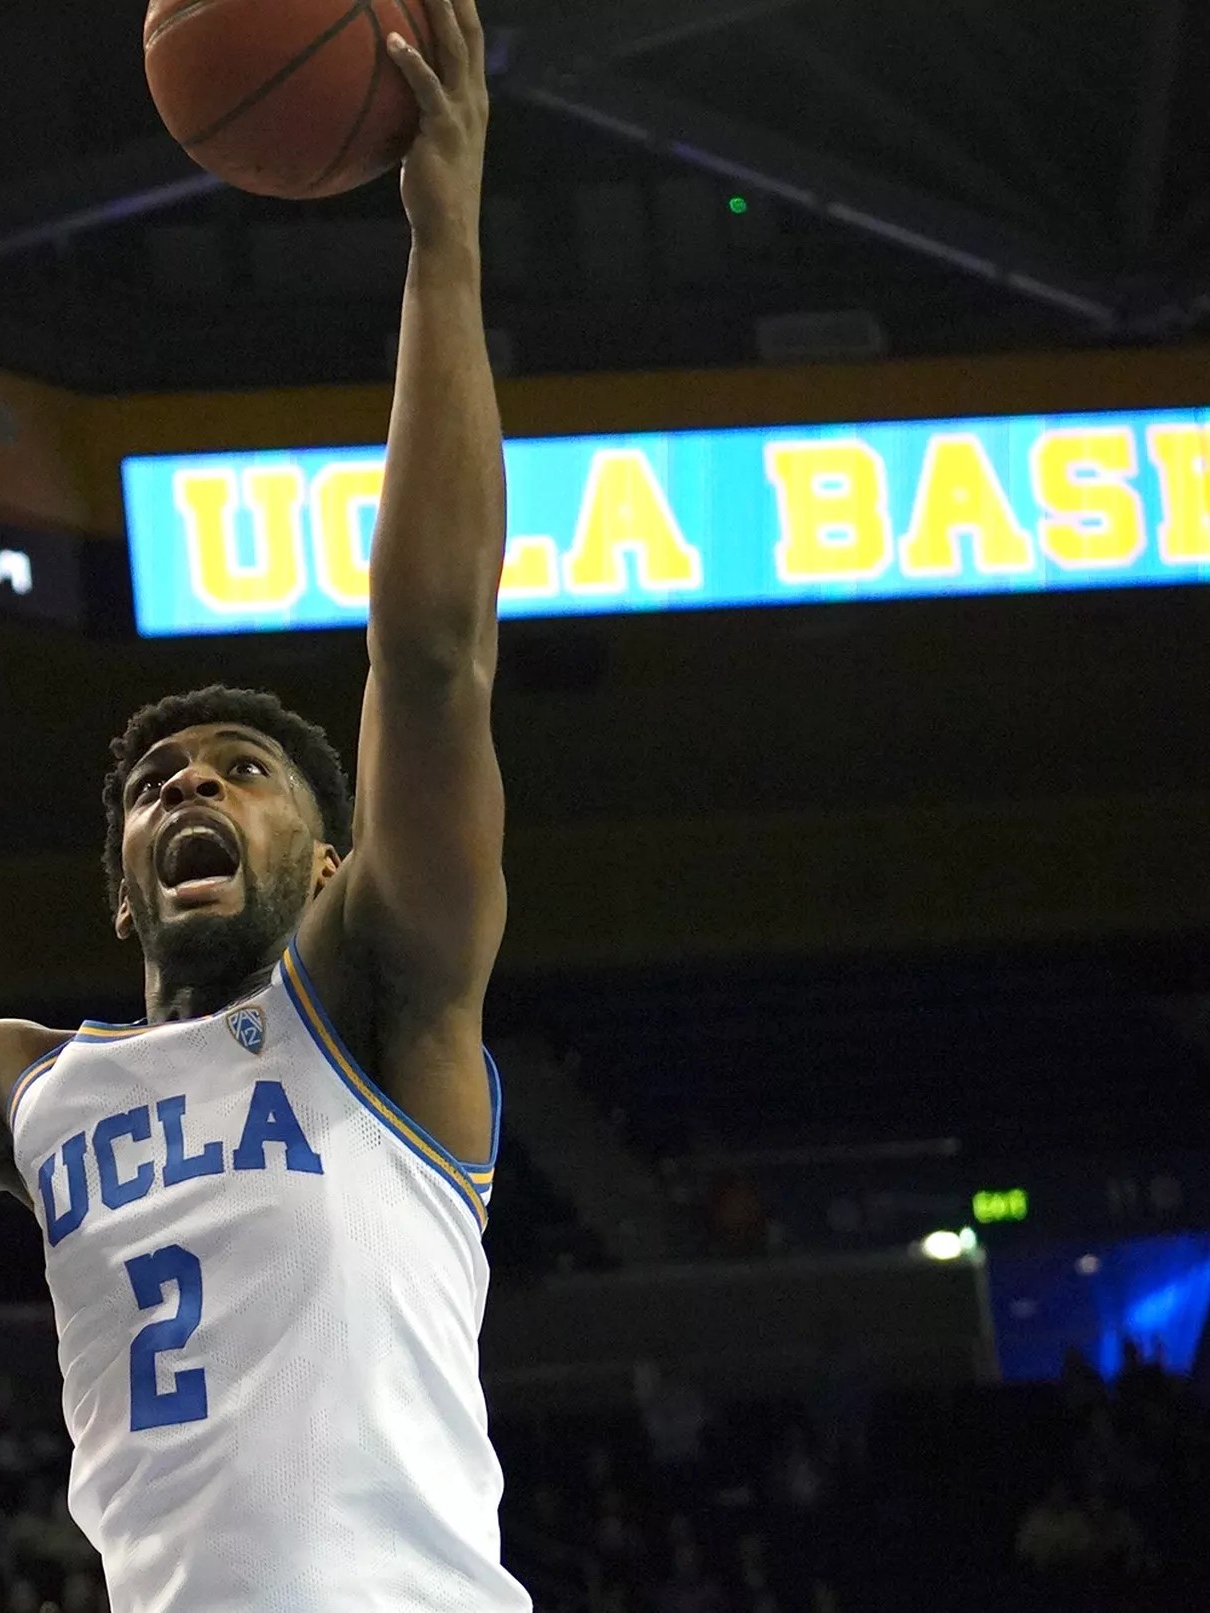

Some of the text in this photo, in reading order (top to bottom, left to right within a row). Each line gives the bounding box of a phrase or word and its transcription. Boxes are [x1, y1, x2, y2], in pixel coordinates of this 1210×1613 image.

[227, 1008, 263, 1040] PAC
[240, 1026, 262, 1047] 12
[37, 1080, 324, 1248] UCLA
[124, 1243, 208, 1432] 2
